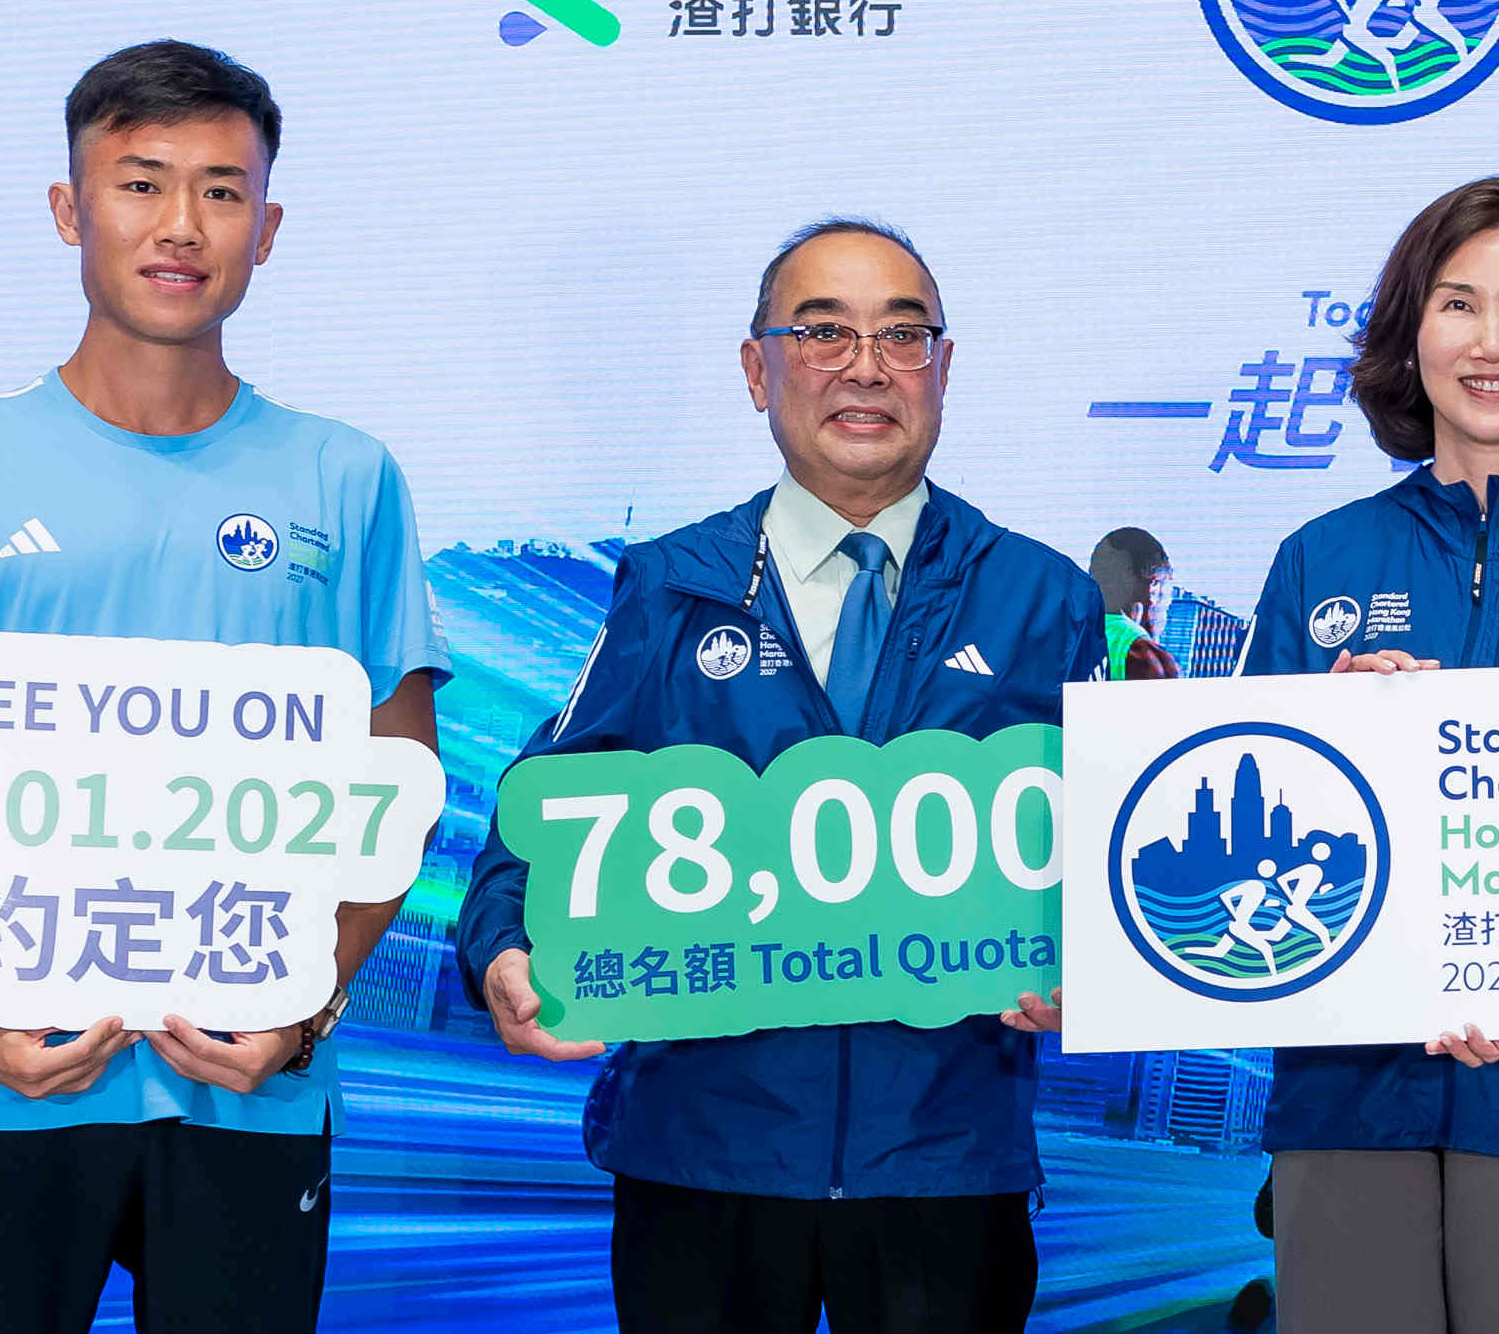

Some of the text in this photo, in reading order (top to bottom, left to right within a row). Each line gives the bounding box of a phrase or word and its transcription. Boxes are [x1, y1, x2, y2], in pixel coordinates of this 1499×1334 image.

[77, 684, 211, 739] YOU
[233, 689, 325, 742] ON
[541, 766, 1062, 926] 78,000
[573, 942, 738, 1001] 總名額
[751, 928, 1058, 986] Total Quota
